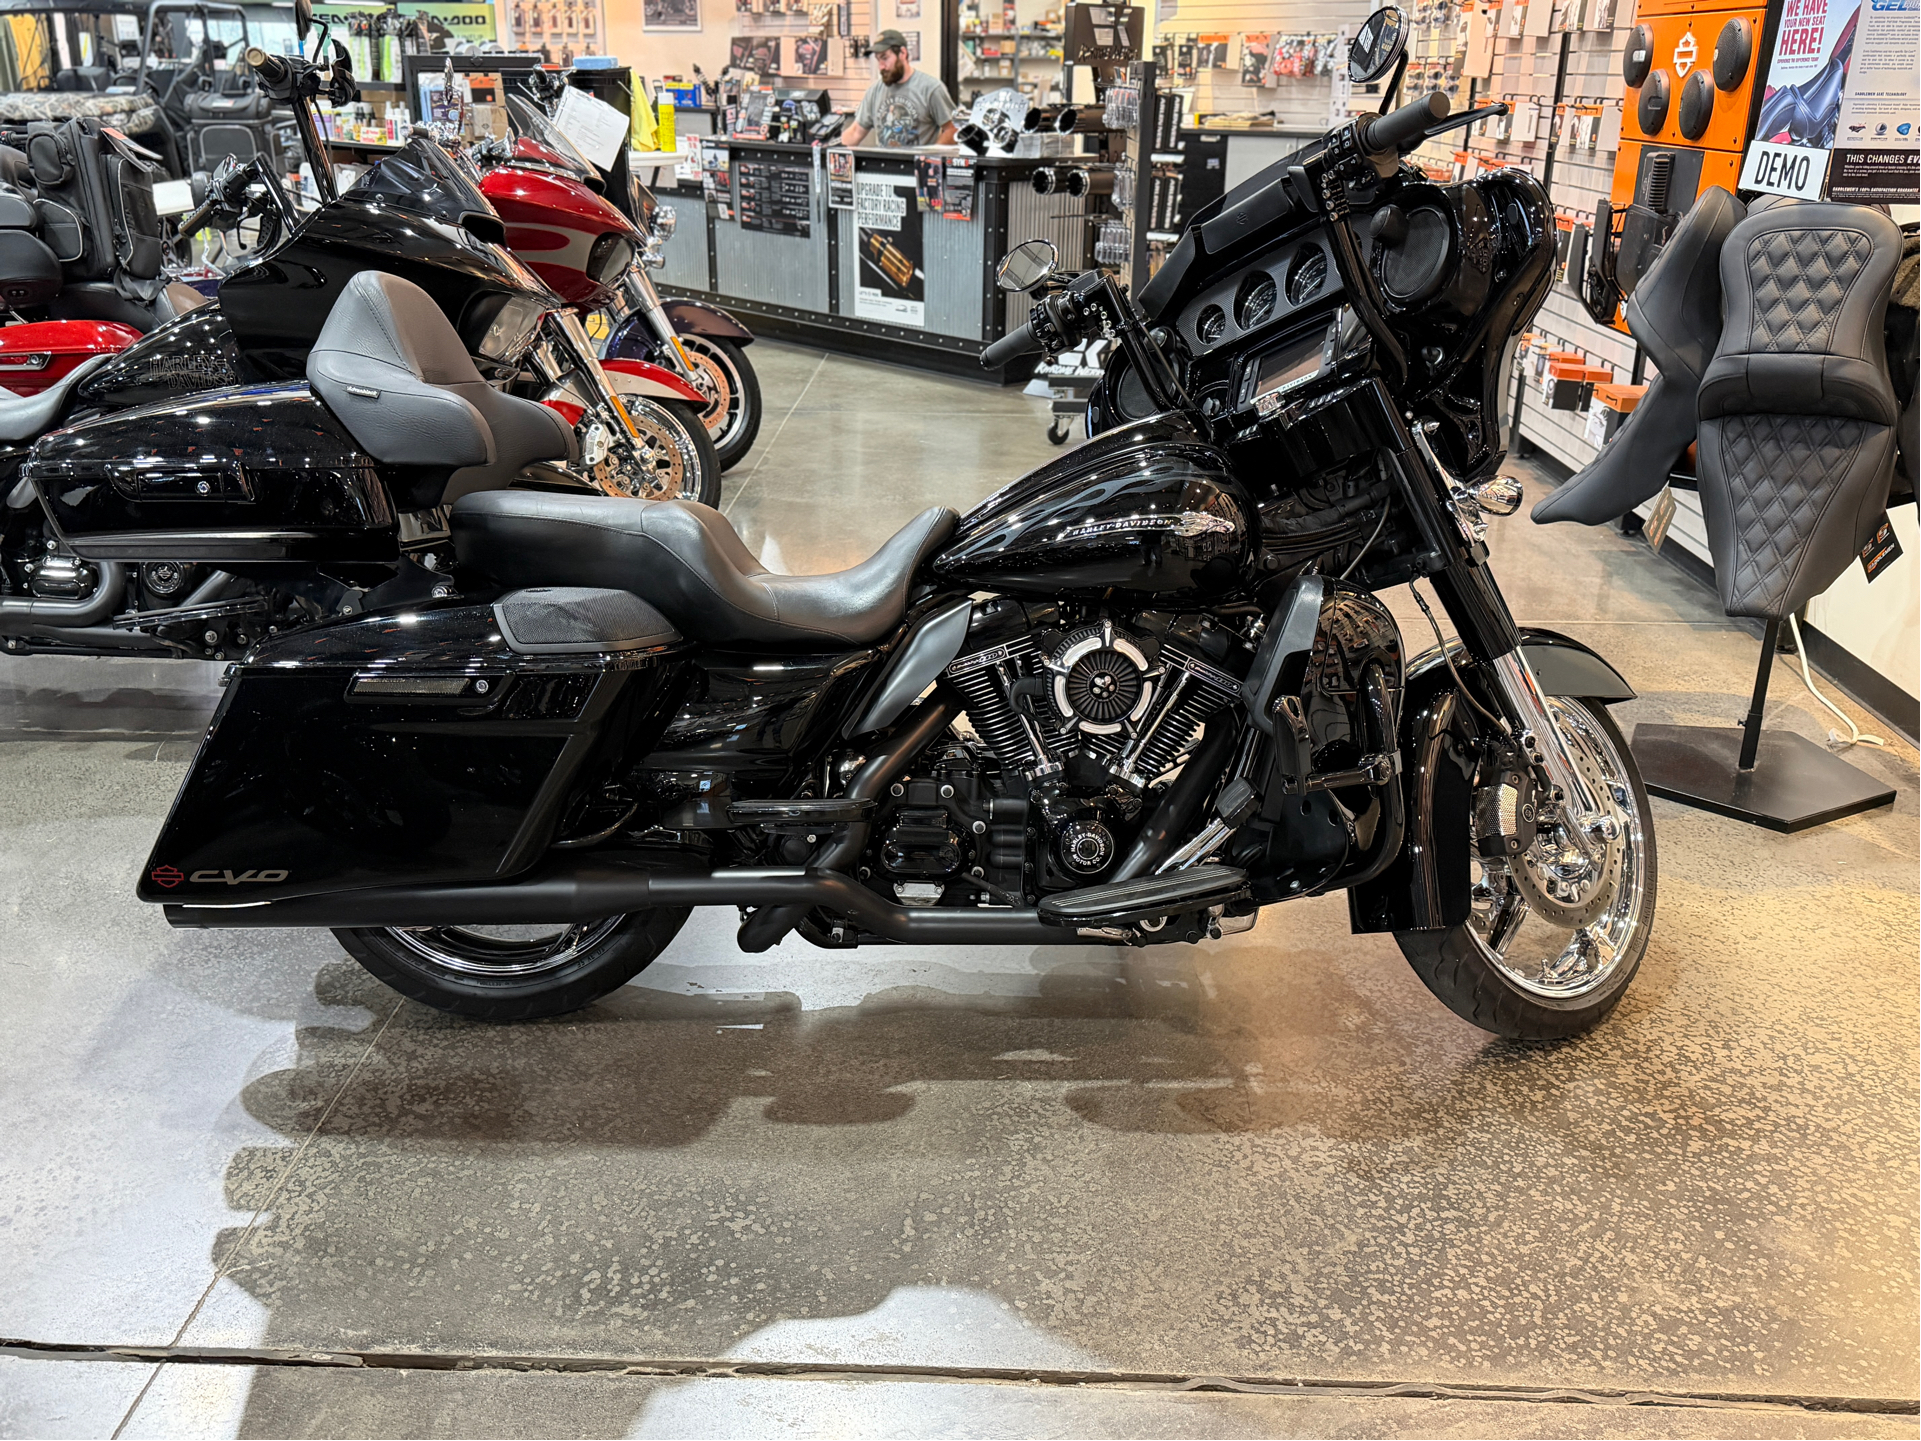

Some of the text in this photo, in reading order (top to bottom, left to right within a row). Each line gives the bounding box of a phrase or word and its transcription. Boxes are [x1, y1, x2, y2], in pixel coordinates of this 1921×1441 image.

[1786, 0, 1828, 18] WE HAVE
[1784, 15, 1826, 29] YOUR NEW SEAT
[1779, 27, 1824, 56] HERE!
[1846, 154, 1865, 163] THIS
[1867, 154, 1905, 164] CHANGES
[1754, 150, 1811, 192] DEMO
[857, 182, 884, 198] UPGRADE
[885, 184, 892, 198] TO
[857, 197, 905, 215] FACTORY RACING
[857, 212, 900, 229] PERFORMANCE
[1072, 519, 1174, 536] HARLEY-DAVIDSON
[189, 869, 290, 885] CVO
